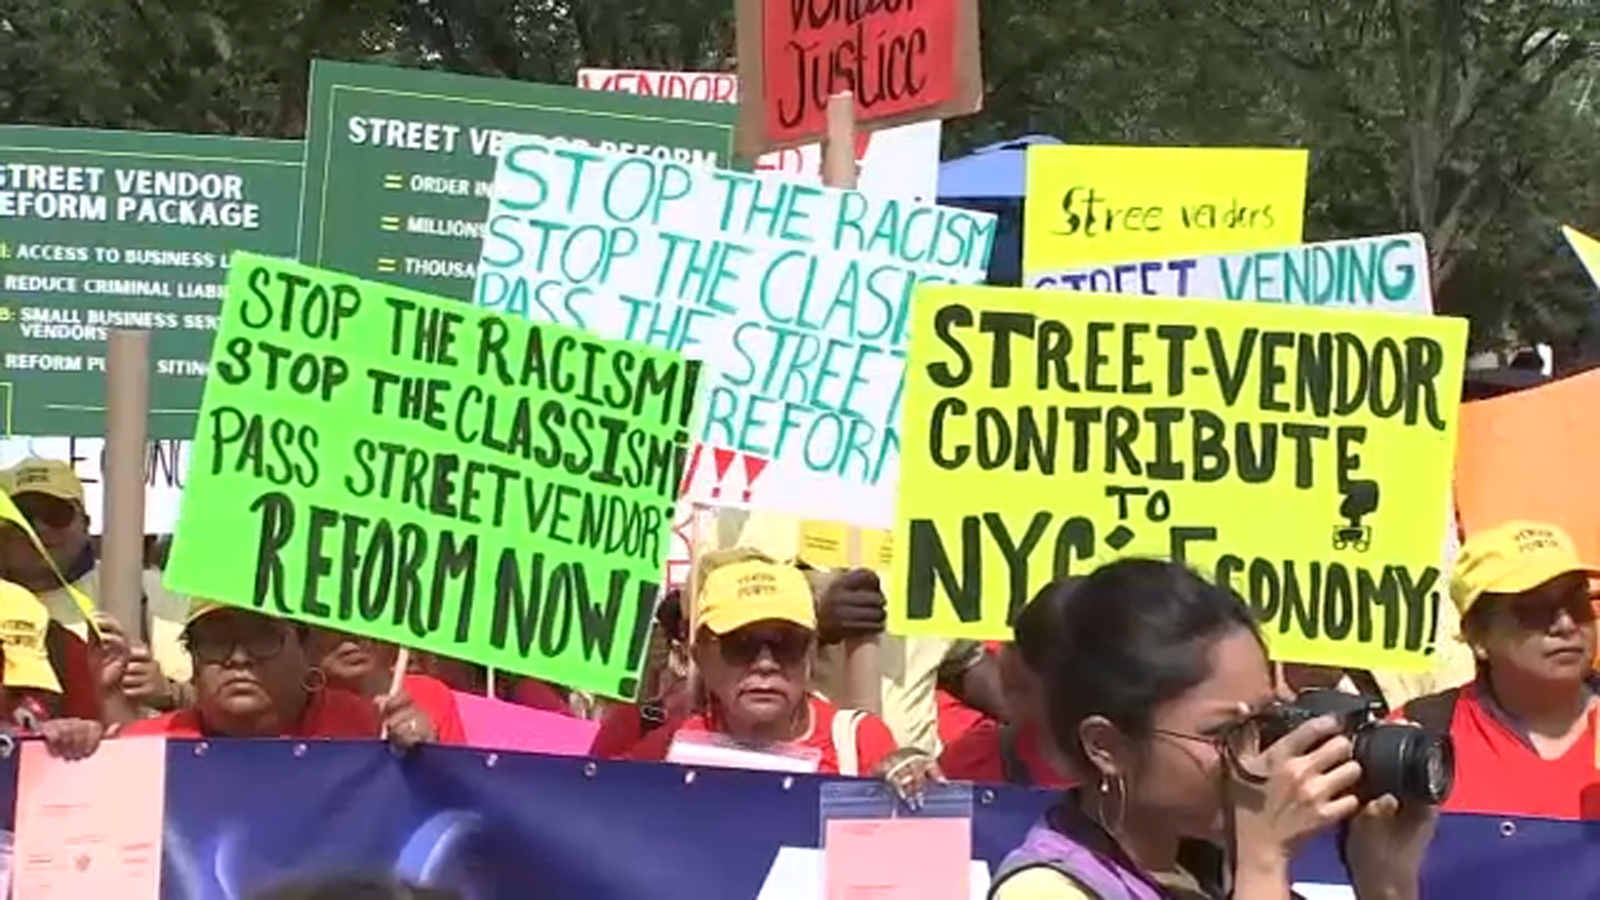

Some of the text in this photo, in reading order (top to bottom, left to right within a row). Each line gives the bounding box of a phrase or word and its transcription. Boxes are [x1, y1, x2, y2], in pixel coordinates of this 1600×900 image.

[349, 115, 460, 153] STREET
[114, 169, 243, 200] VENDOR
[410, 174, 470, 197] ORDER
[495, 143, 998, 272] STOP THE RACISM
[116, 196, 260, 229] PACKAGE
[16, 244, 89, 261] ACCESS
[95, 247, 120, 264] TO
[125, 249, 217, 269] BUSINESS
[481, 215, 638, 284] STOP
[656, 232, 756, 315] THE
[1219, 239, 1416, 305] VENDING
[4, 274, 78, 293] REDUCE
[83, 278, 172, 297] CRIMINAL
[20, 306, 81, 324] SMALL
[87, 309, 179, 330] BUSINESS
[4, 352, 82, 372] REFORM
[239, 266, 702, 444] STOP THE RACISM!
[926, 303, 1447, 430] STREET-VENDOR
[216, 337, 349, 403] STOP
[367, 368, 452, 431] THE
[928, 396, 1369, 494] CONTRIBUTE
[209, 405, 662, 569] PASS STREET VENDOR
[1104, 484, 1171, 522] TO
[250, 491, 662, 698] REFORM NOW!
